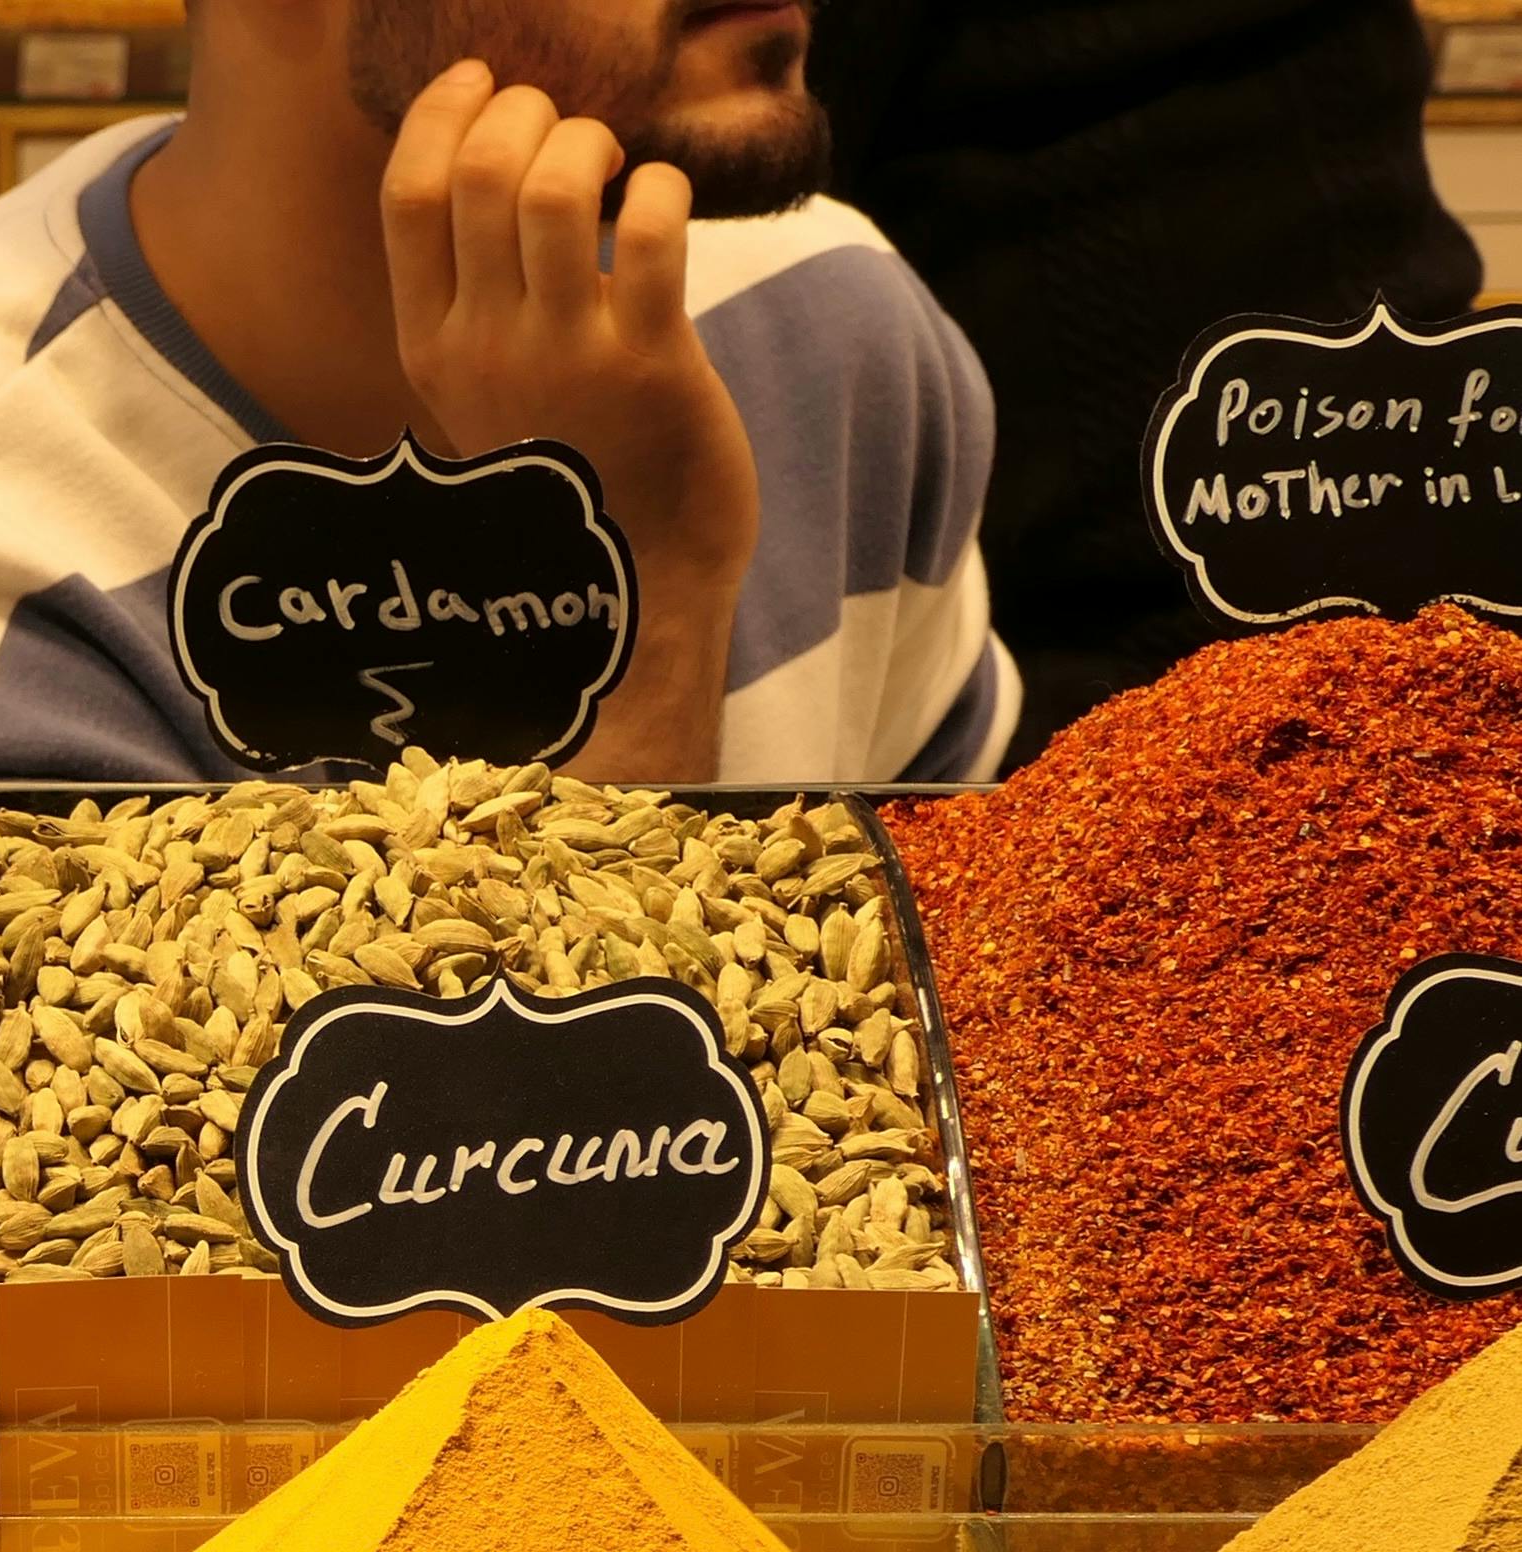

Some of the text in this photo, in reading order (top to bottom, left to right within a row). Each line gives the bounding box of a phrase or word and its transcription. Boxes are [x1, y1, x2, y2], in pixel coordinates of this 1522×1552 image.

[1216, 368, 1522, 447] Poison fo
[1423, 466, 1472, 508] in
[218, 559, 619, 642] Cardamon
[295, 1080, 739, 1230] Curcuma
